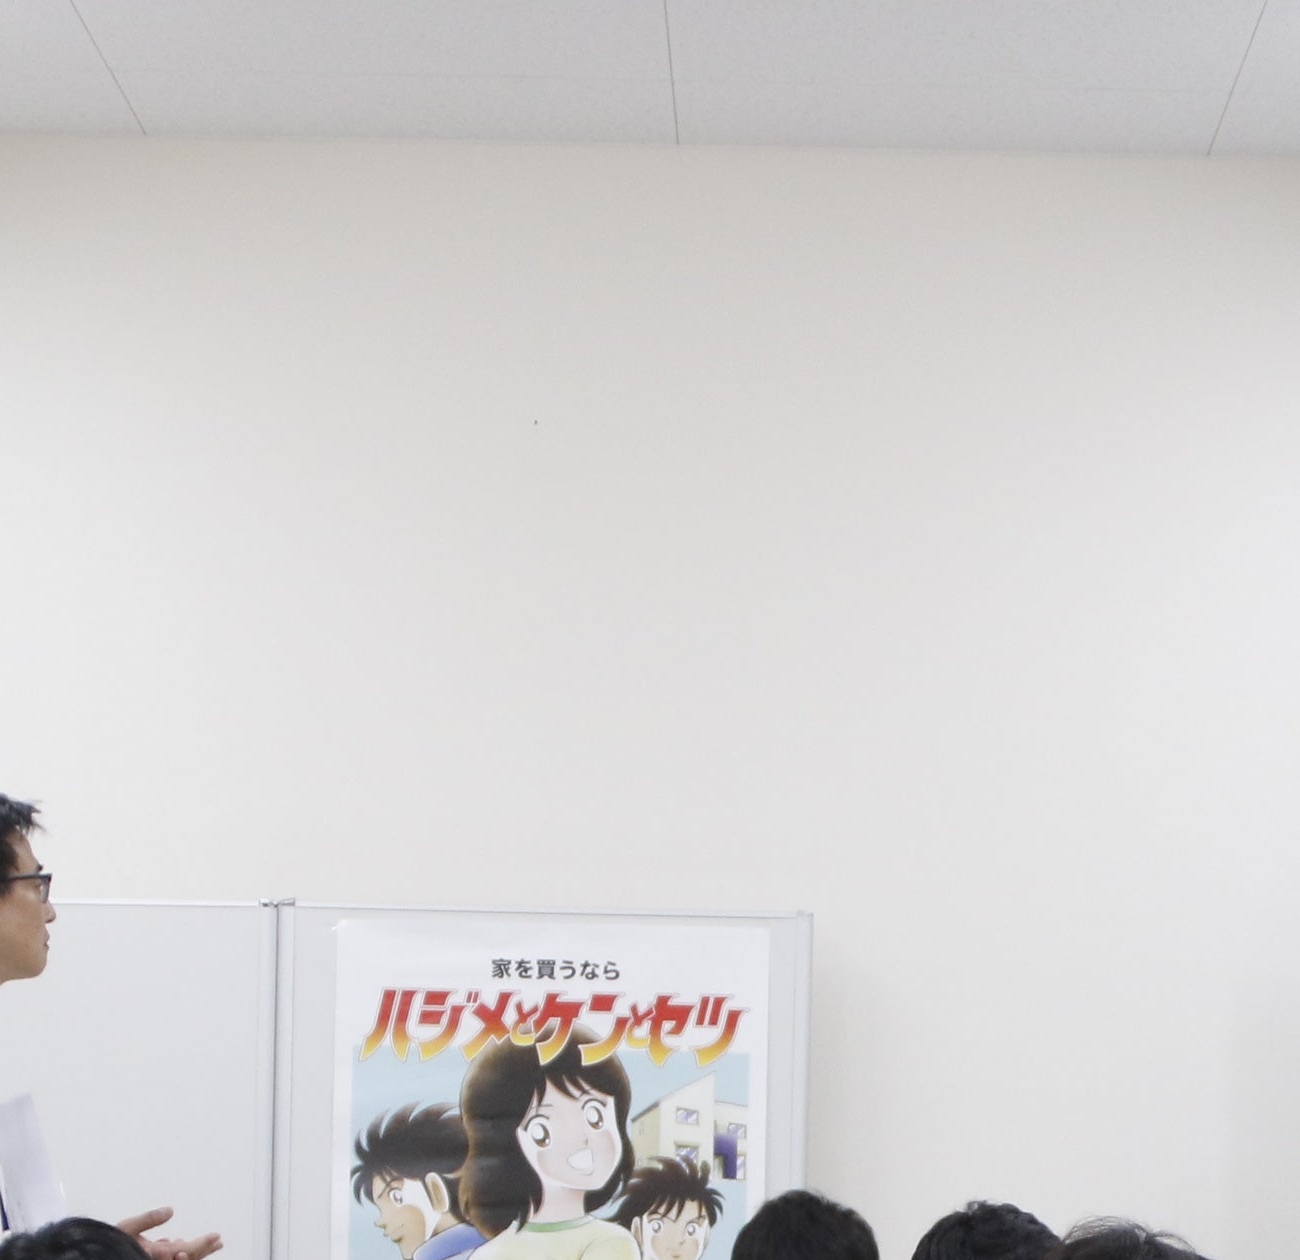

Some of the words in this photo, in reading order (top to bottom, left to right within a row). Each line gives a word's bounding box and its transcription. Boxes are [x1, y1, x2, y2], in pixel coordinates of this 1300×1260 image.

[491, 958, 621, 981] 家を買うなら
[358, 986, 752, 1067] ハジメとケンとセツ
